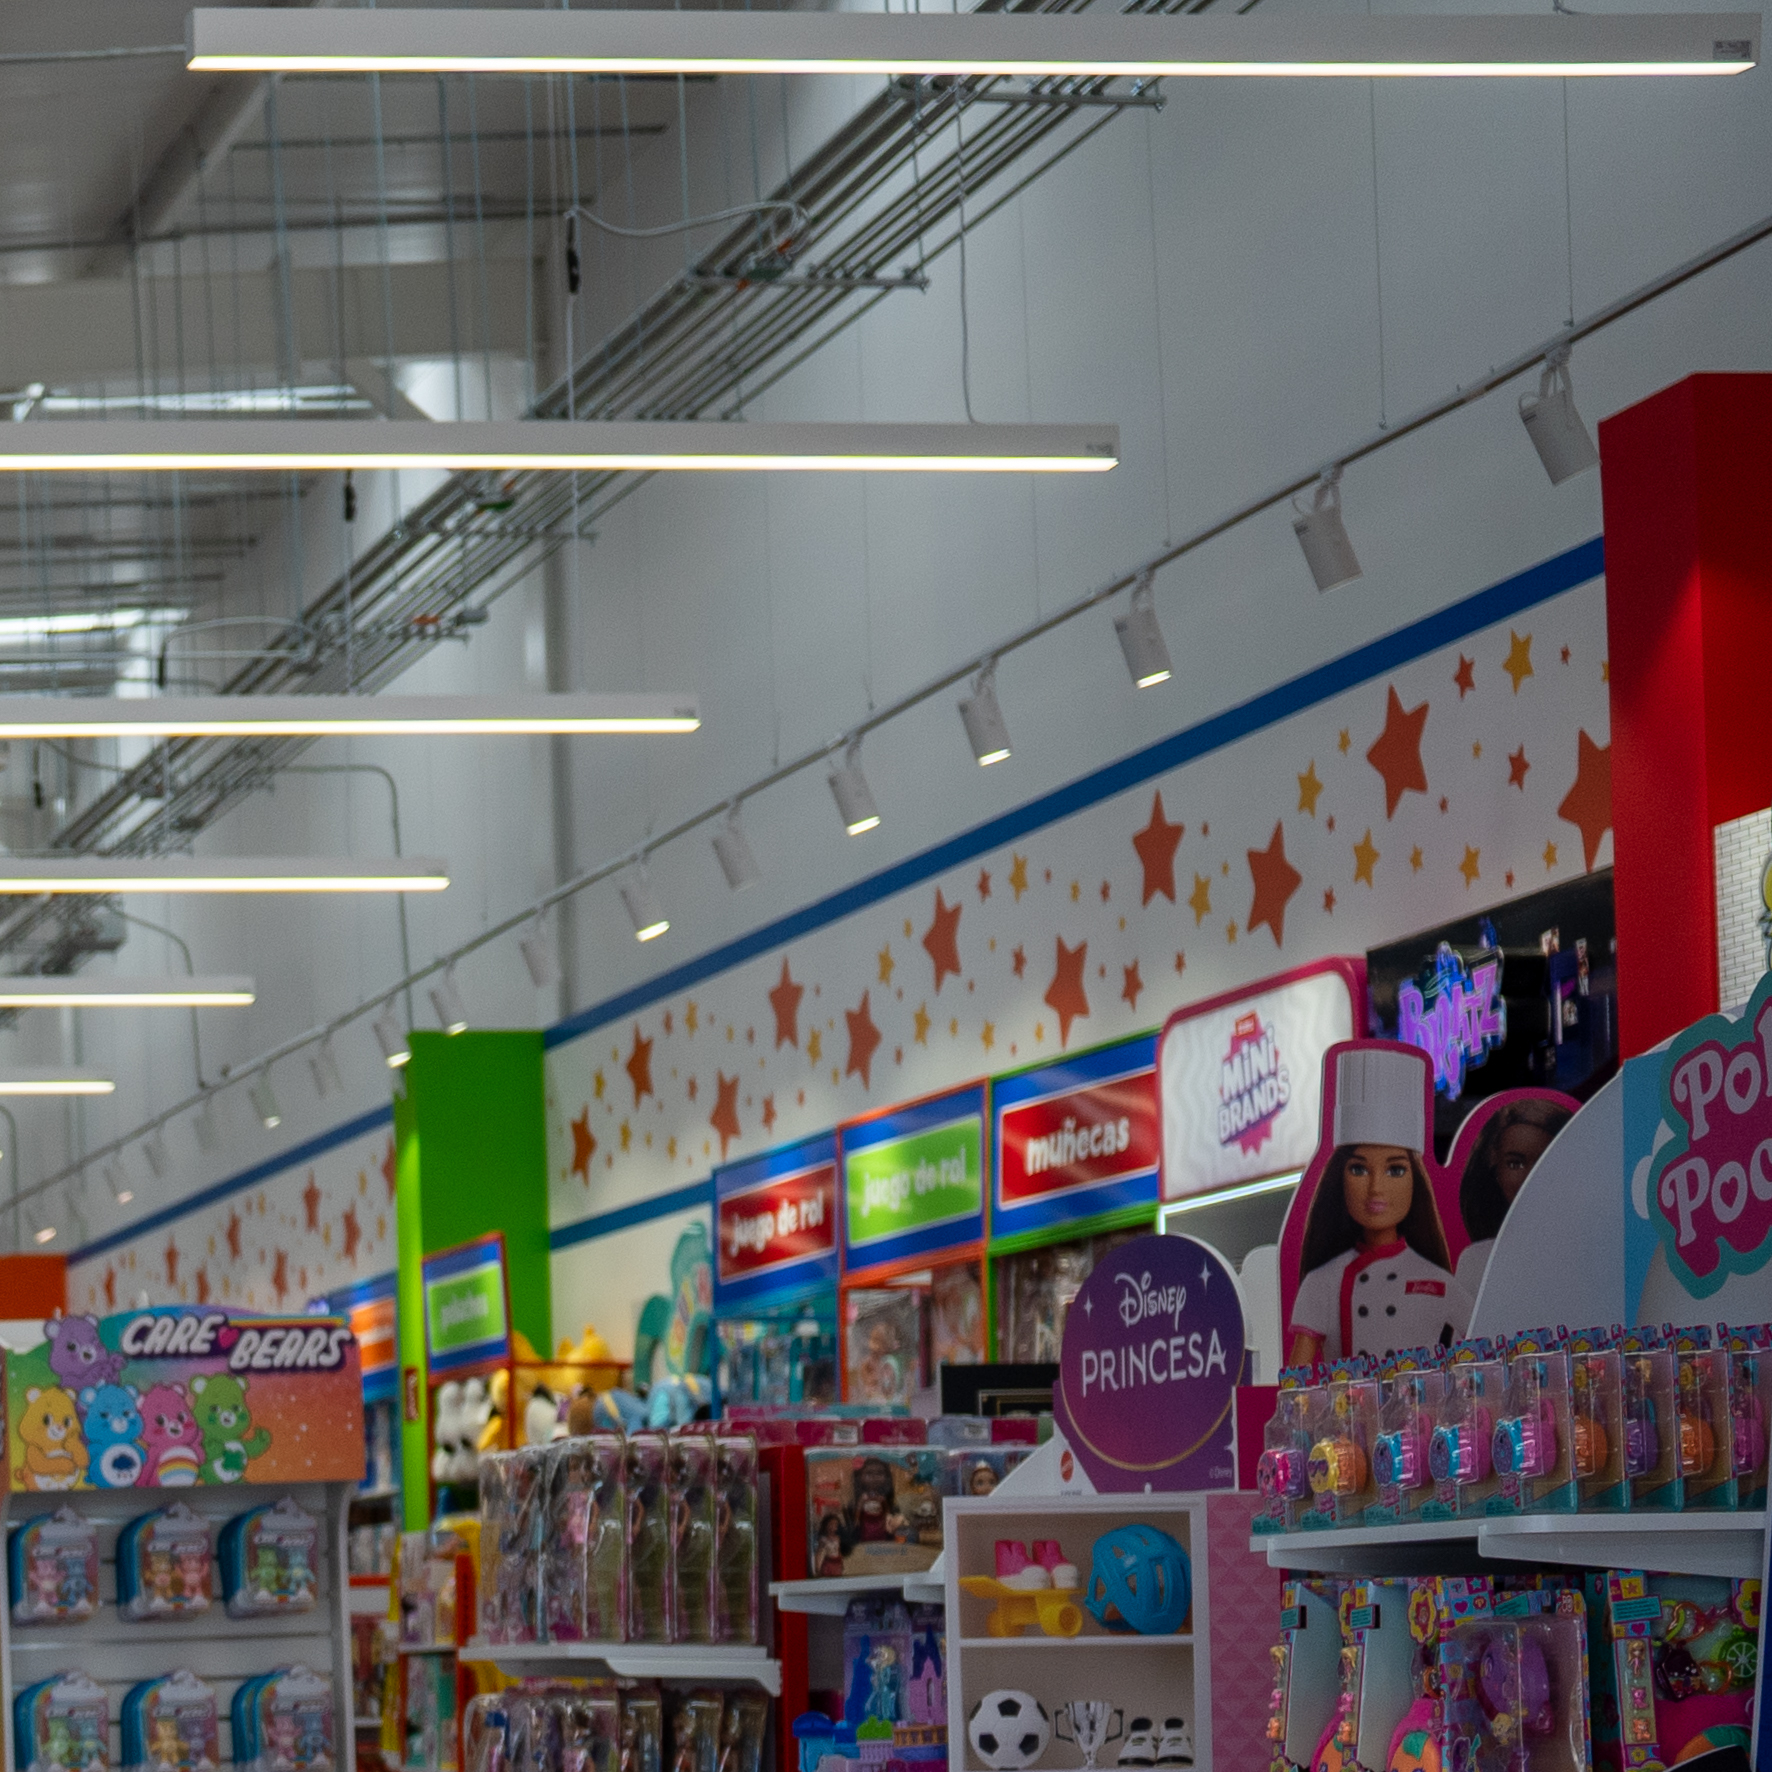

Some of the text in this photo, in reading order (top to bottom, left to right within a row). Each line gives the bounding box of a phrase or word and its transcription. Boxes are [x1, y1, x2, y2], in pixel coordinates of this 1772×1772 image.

[1217, 1068, 1292, 1146] BRANDS
[1026, 1115, 1131, 1177] muñecas
[1113, 1269, 1188, 1332] Disney
[120, 1313, 352, 1372] CARE BEARS
[1081, 1327, 1227, 1398] PRINCESA
